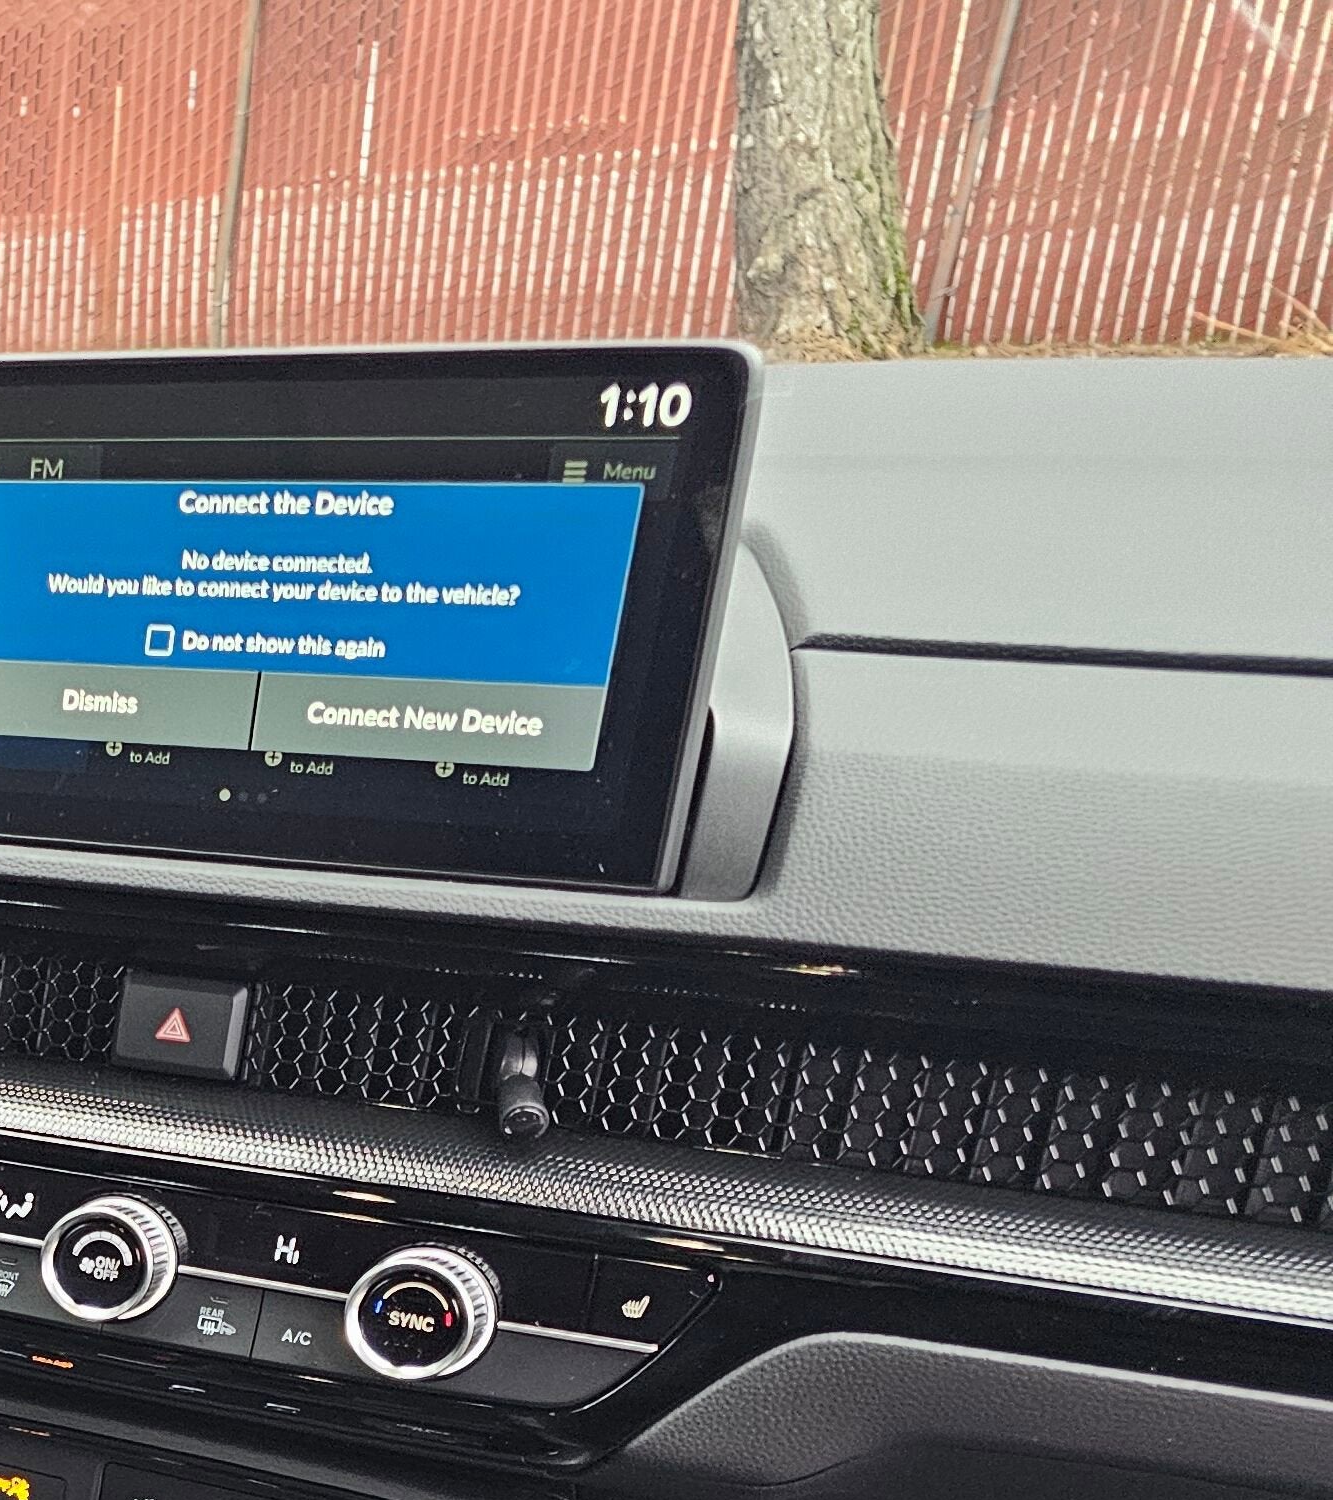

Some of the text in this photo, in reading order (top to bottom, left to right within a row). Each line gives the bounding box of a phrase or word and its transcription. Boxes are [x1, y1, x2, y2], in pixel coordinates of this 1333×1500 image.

[600, 382, 693, 428] 1:10
[30, 458, 65, 479] FM
[603, 462, 658, 480] Menu
[179, 490, 395, 517] Connect the Device
[182, 549, 374, 574] No device connected.
[48, 573, 521, 606] Would you like to connect your device to the vehicle?
[182, 630, 386, 660] Do not show this again
[62, 689, 139, 715] Dismiss
[307, 701, 544, 737] Connect New Device
[129, 751, 171, 766] to Add
[290, 761, 334, 776] to Add
[462, 772, 510, 788] to Add
[95, 1255, 121, 1271] ON/
[93, 1268, 119, 1282] OFF
[199, 1306, 225, 1318] REAR
[388, 1311, 435, 1333] SYNC
[281, 1329, 312, 1346] A/C
